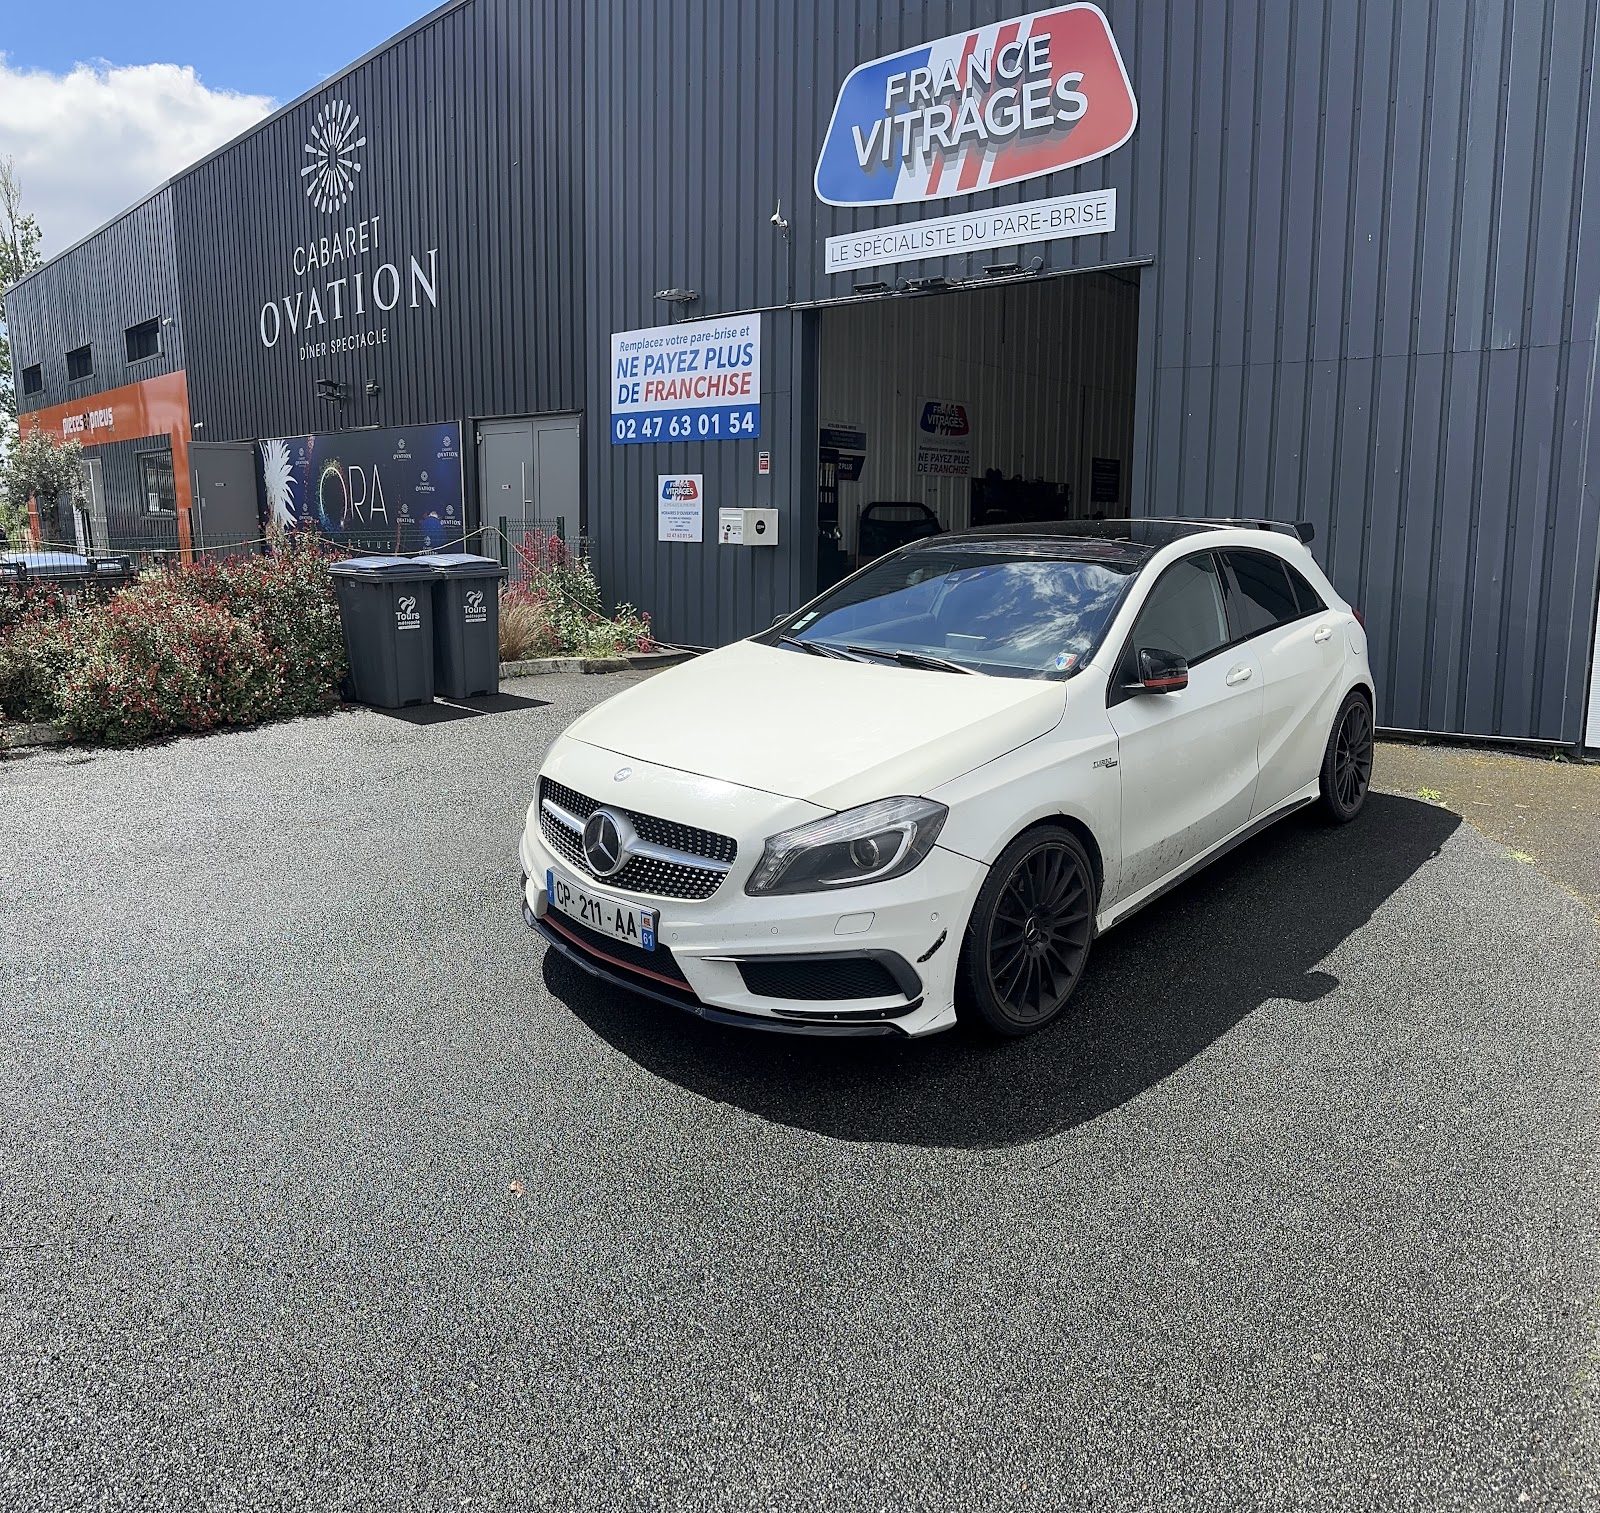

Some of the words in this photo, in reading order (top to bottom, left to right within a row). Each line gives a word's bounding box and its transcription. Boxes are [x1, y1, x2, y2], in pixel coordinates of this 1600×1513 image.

[884, 32, 1052, 110] FRANCE
[852, 72, 1088, 167] VITRAGES
[293, 215, 380, 276] CABARET
[831, 247, 849, 262] LE
[854, 227, 956, 258] SPÉCIALISTE
[962, 222, 987, 242] DU
[993, 202, 1107, 236] PARE-BRISE
[260, 248, 438, 348] OVATION
[300, 341, 326, 360] DÎNER
[330, 328, 387, 354] SPECTACLE
[619, 338, 663, 352] Remplacez
[666, 334, 688, 346] votre
[690, 328, 737, 346] pare-brise
[740, 326, 750, 337] et
[616, 356, 640, 379] NE
[644, 348, 700, 376] PAYEZ
[704, 343, 754, 370] PLUS
[618, 382, 640, 404] DE
[644, 372, 752, 402] FRANCHISE
[928, 414, 964, 427] VITRAGES
[933, 406, 958, 416] FRANCE
[616, 418, 636, 439] 02
[642, 417, 663, 437] 47
[669, 415, 691, 436] 63
[698, 414, 720, 435] 01
[729, 412, 754, 433] 54
[918, 453, 928, 461] NE
[931, 454, 953, 463] PAYEZ
[954, 455, 970, 464] PLUS
[918, 463, 928, 472] DE
[930, 464, 968, 474] FRANCHISE
[395, 612, 420, 620] Tours
[463, 605, 486, 614] Tours
[643, 933, 653, 947] 61
